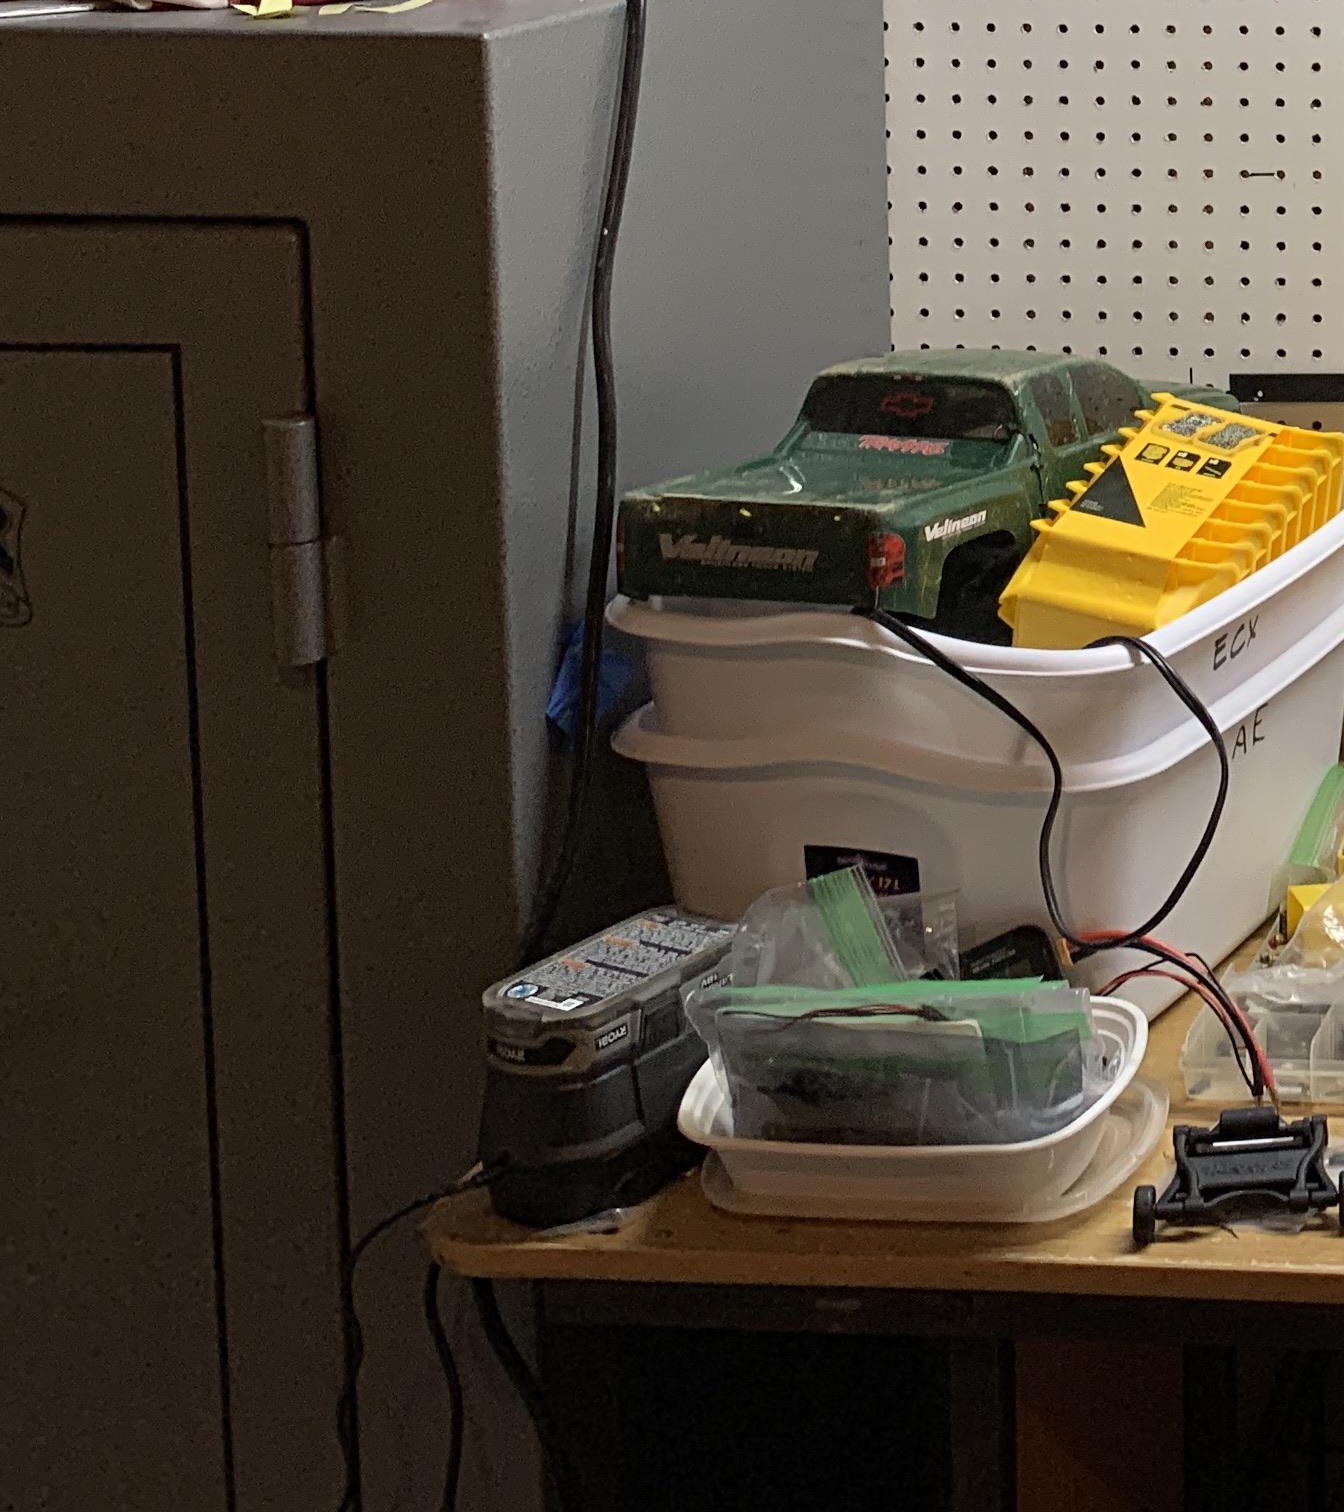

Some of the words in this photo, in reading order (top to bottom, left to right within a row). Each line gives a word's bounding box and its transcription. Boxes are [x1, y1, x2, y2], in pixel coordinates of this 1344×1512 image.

[922, 510, 988, 542] Velineon
[1212, 615, 1259, 672] ECX
[1231, 702, 1269, 760] AE
